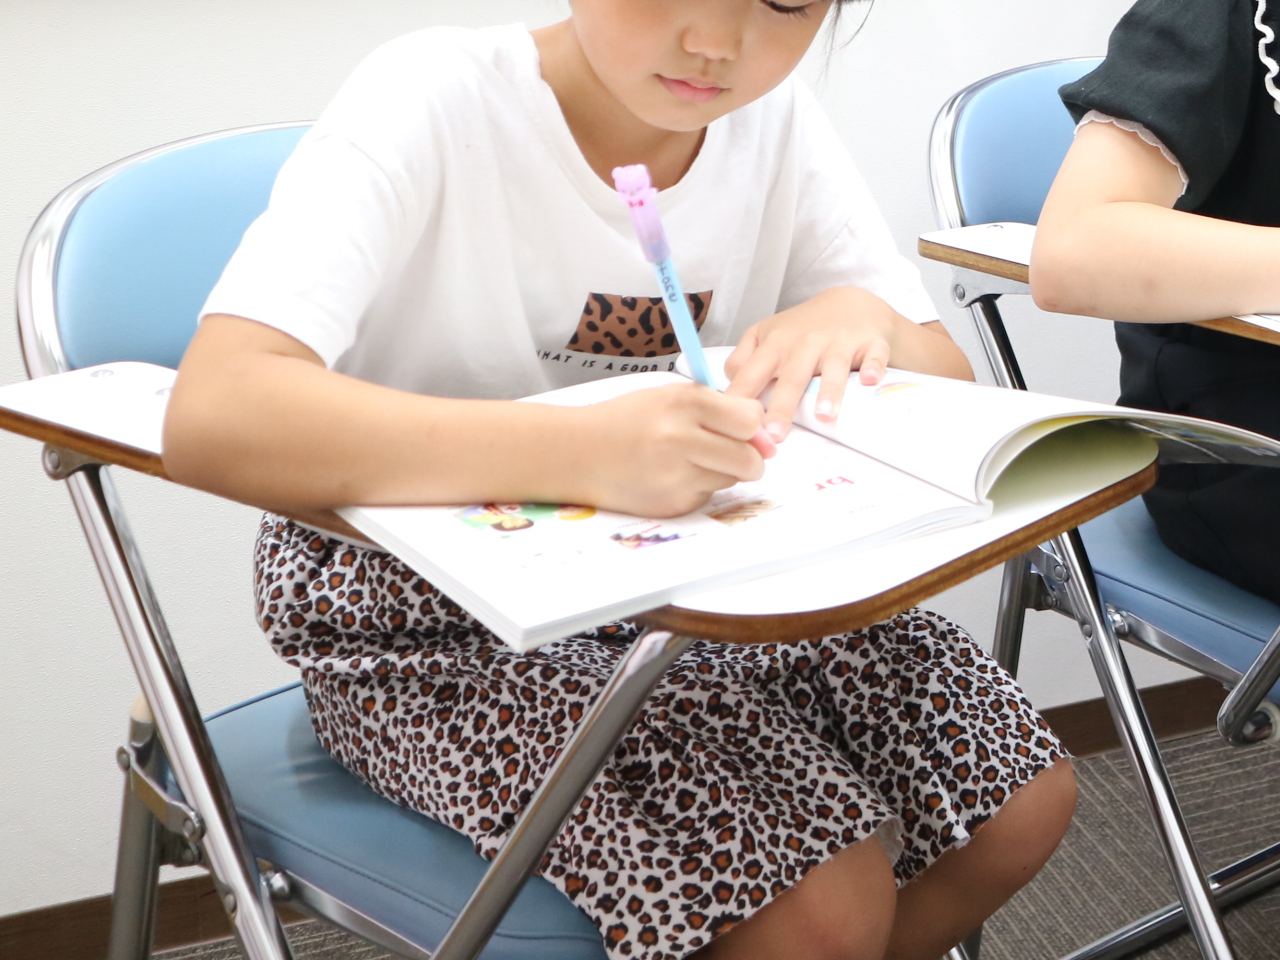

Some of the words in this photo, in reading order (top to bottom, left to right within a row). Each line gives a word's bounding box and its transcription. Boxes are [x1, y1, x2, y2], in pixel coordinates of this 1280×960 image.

[582, 359, 596, 368] IS
[604, 362, 613, 370] A
[621, 363, 657, 372] GOOD
